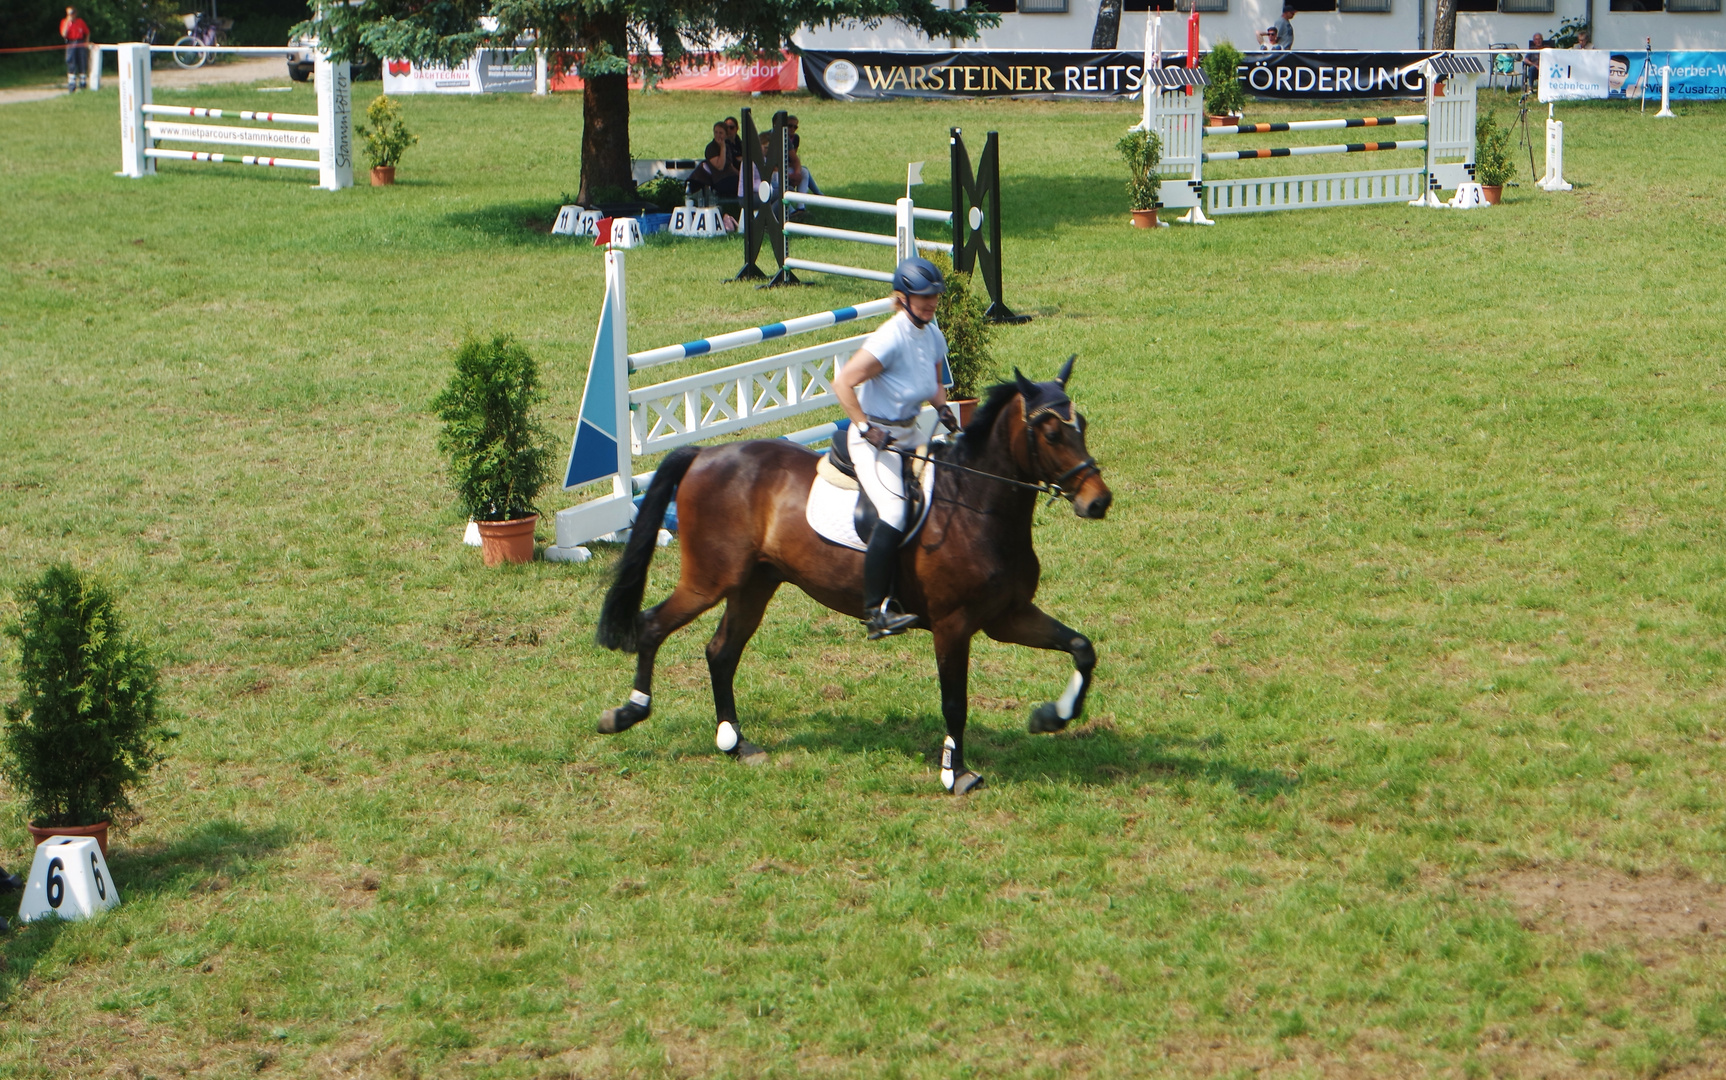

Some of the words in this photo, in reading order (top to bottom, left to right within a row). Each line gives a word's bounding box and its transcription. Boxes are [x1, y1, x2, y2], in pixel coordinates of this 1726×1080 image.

[413, 71, 471, 80] DACHTECHNIK
[863, 65, 1055, 91] WARSTEINER
[1549, 82, 1600, 90] technicum
[159, 126, 311, 145] www.mietparcours-stammkoetter.de
[1459, 187, 1465, 204] 3
[1473, 187, 1480, 205] 3
[561, 211, 569, 230] 11
[582, 216, 594, 235] 12
[675, 212, 684, 230] B
[696, 213, 706, 231] A
[714, 213, 722, 231] A
[614, 224, 624, 242] 14
[47, 856, 64, 909] 6
[91, 851, 106, 901] 6
